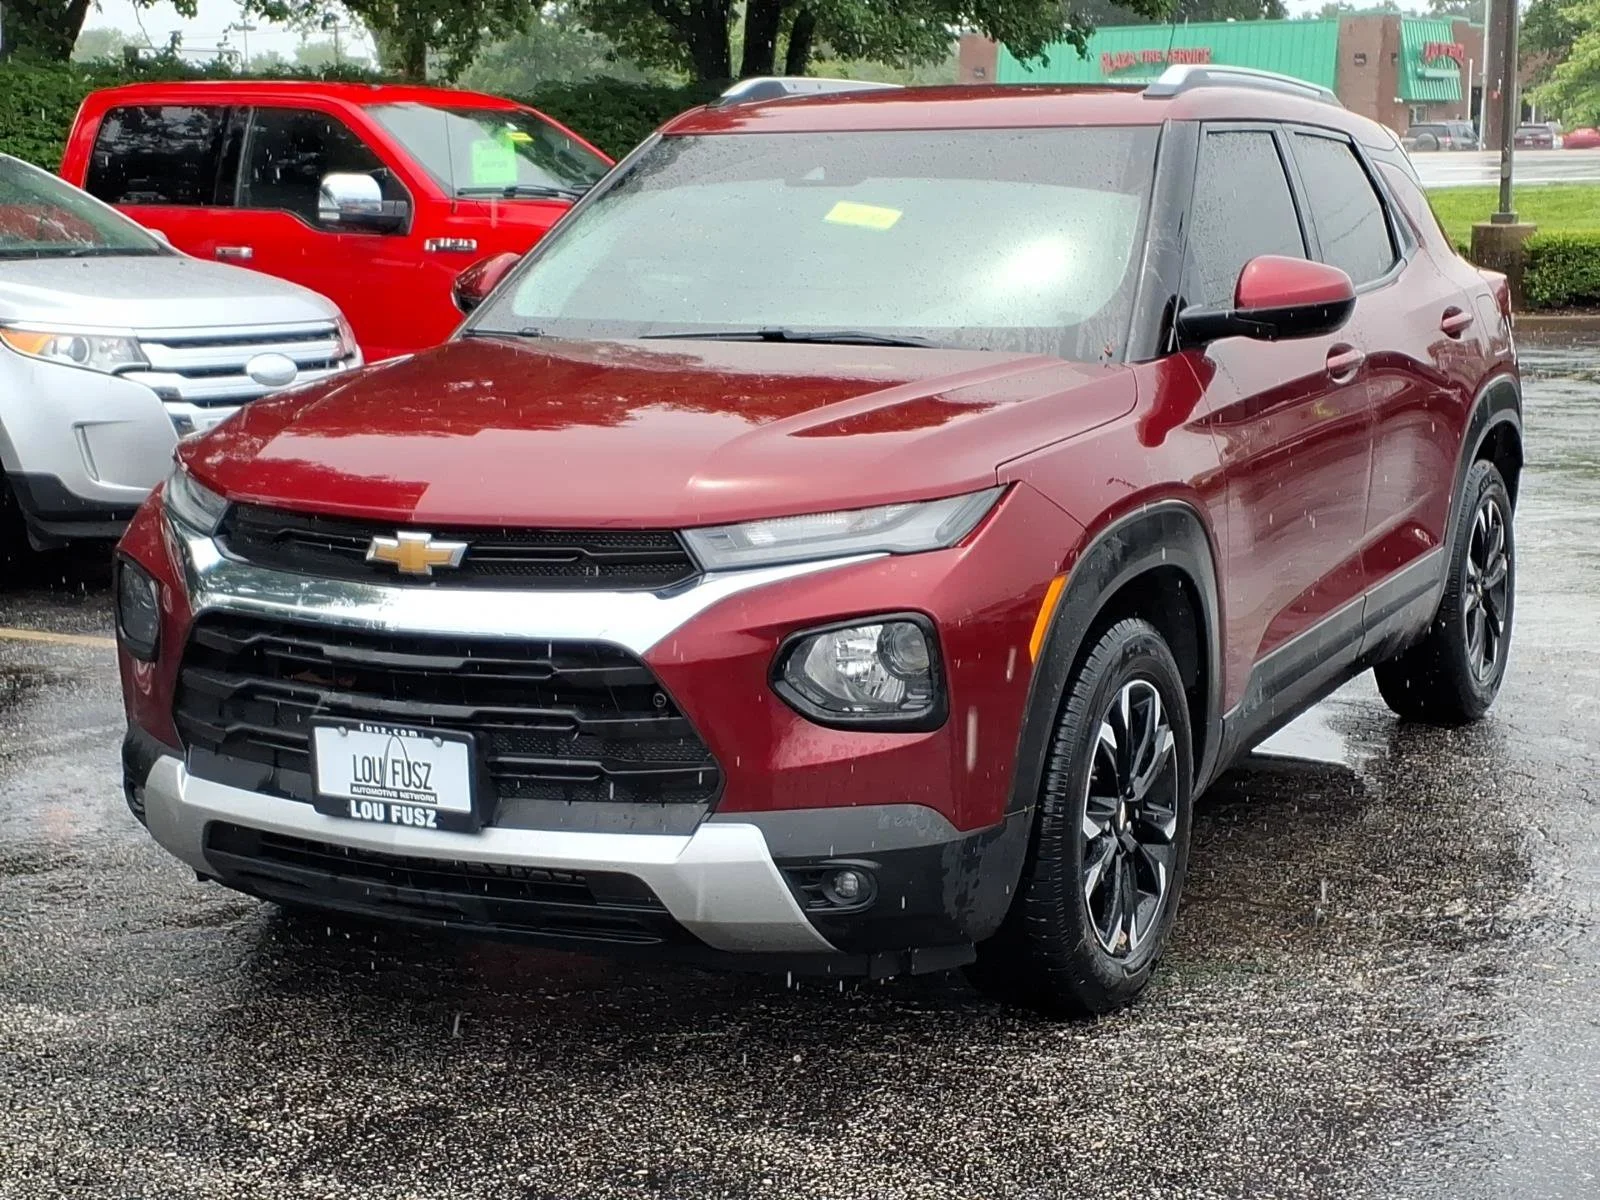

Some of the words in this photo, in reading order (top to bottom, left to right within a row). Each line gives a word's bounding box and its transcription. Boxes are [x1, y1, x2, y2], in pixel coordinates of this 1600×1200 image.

[1102, 51, 1136, 74] PLAZA
[1140, 50, 1163, 64] TIRE
[1165, 48, 1211, 64] SERVICE
[360, 723, 418, 737] fusz.com
[352, 753, 383, 785] LOU
[391, 758, 433, 790] FUSZ
[352, 786, 398, 798] AUTOMOTIVE
[399, 791, 436, 802] NETWORK
[350, 799, 385, 822] LOU
[391, 803, 438, 829] FUSZ
